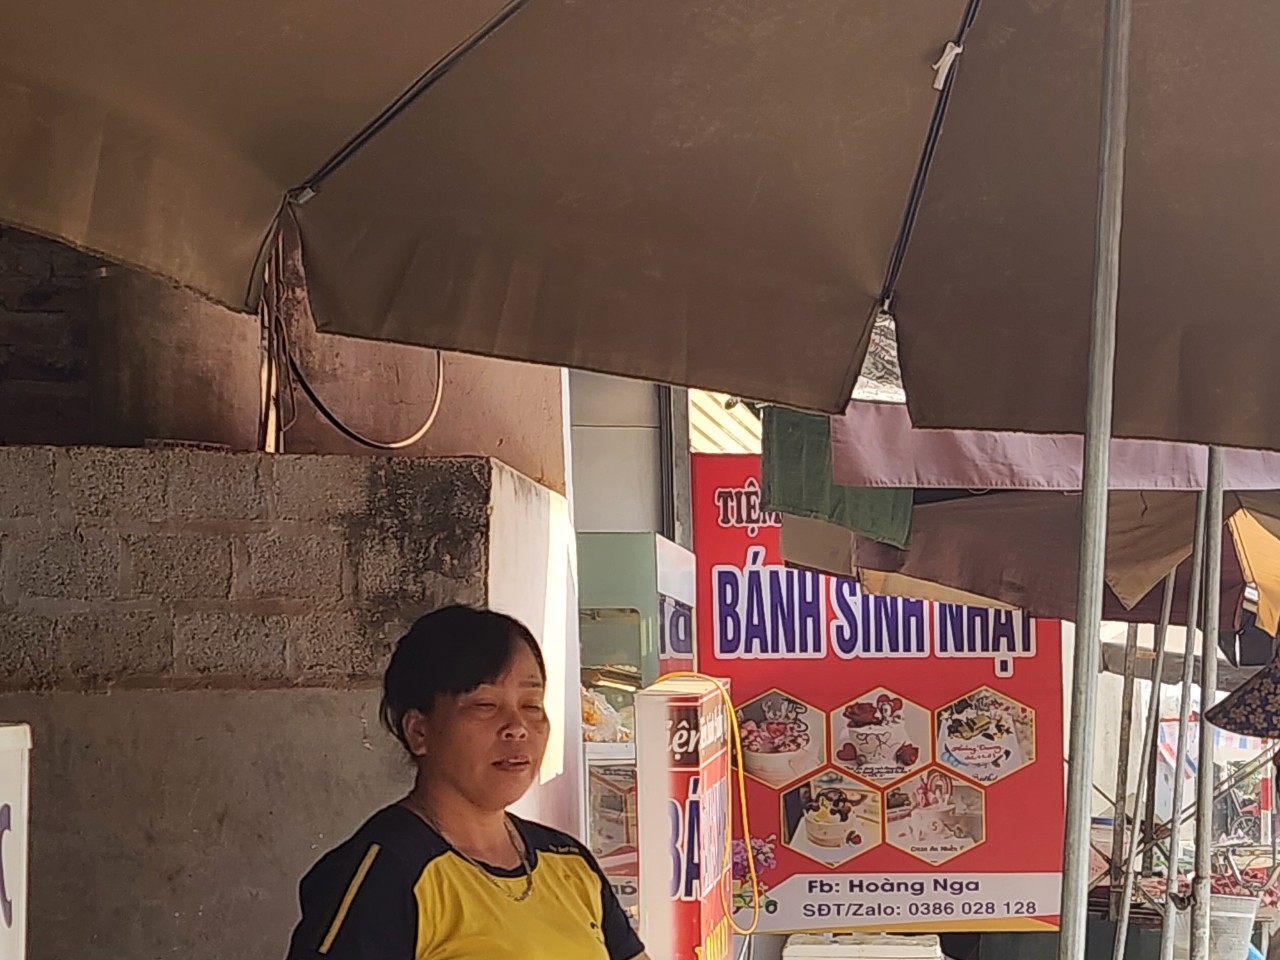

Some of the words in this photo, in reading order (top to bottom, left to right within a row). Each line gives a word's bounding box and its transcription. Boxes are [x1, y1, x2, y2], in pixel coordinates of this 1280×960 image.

[716, 550, 822, 654] BÁNH
[834, 577, 925, 655] SINH
[807, 879, 841, 894] Fb:
[849, 877, 925, 896] Hoàng
[932, 878, 980, 895] Nga
[803, 902, 902, 917] SĐT/Zalo:
[908, 901, 955, 916] 0386
[961, 901, 996, 915] 028
[1003, 901, 1037, 915] 128
